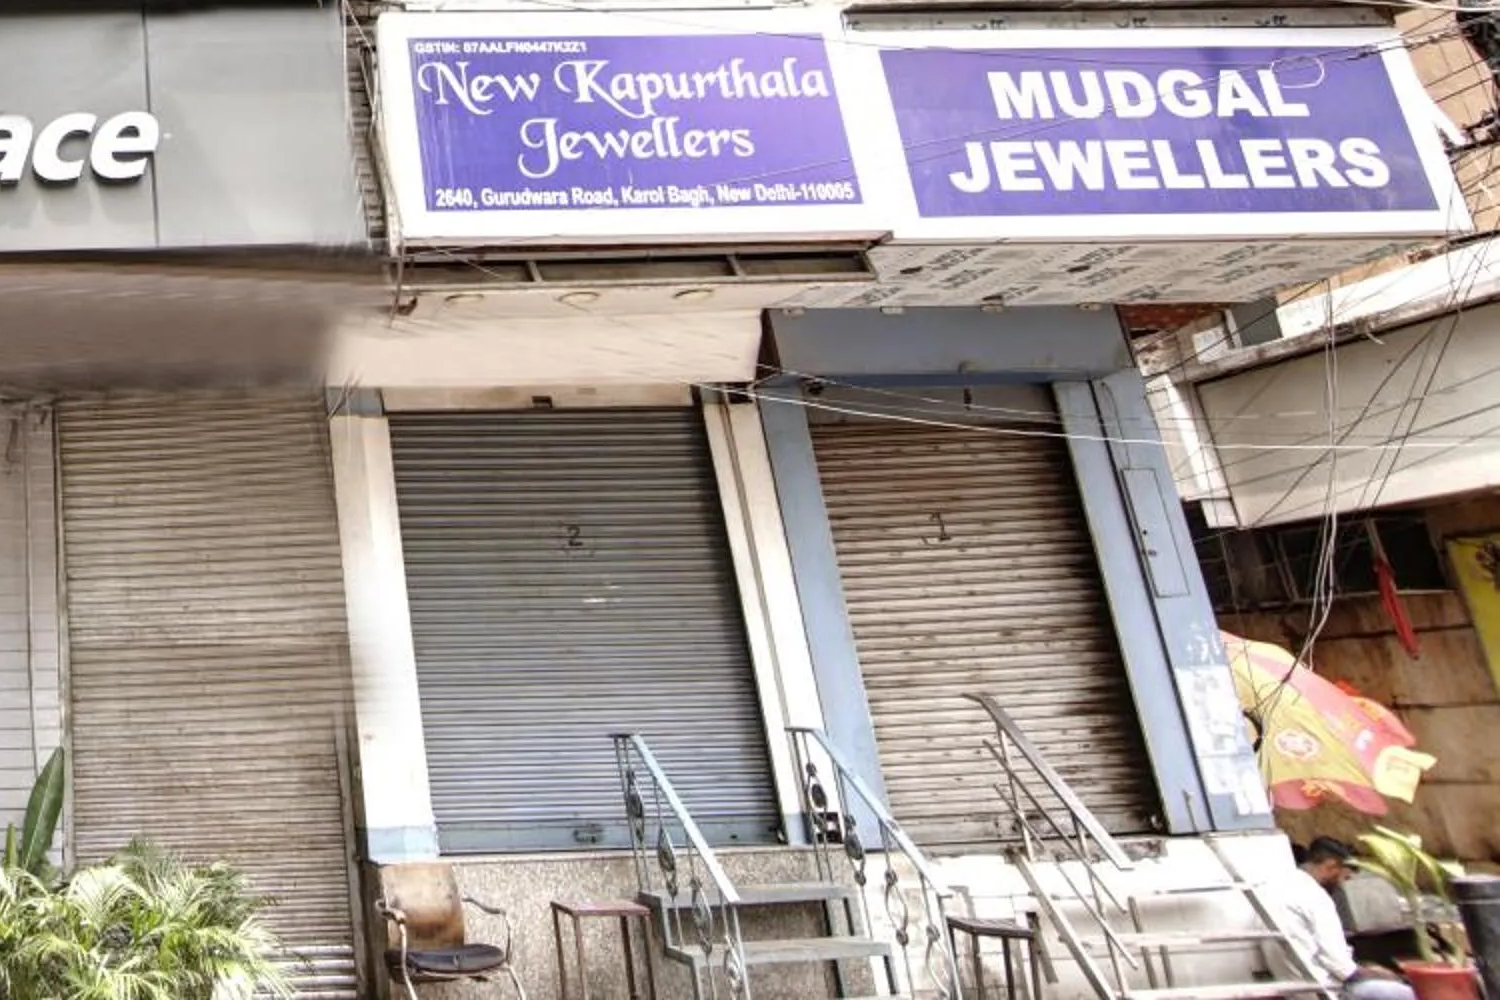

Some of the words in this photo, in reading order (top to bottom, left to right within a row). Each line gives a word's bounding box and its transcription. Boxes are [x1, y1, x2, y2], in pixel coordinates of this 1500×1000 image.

[417, 60, 541, 115] New
[553, 57, 830, 119] Kapurthala
[987, 68, 1310, 120] MUDGAL
[516, 116, 756, 178] Jewellers
[949, 137, 1390, 194] JEWELLERS
[481, 187, 568, 206] Gurudwara
[570, 186, 619, 208] Road,
[621, 185, 664, 204] Karol
[666, 185, 715, 207] Bagh,
[717, 184, 751, 202] New
[566, 523, 584, 547] 2
